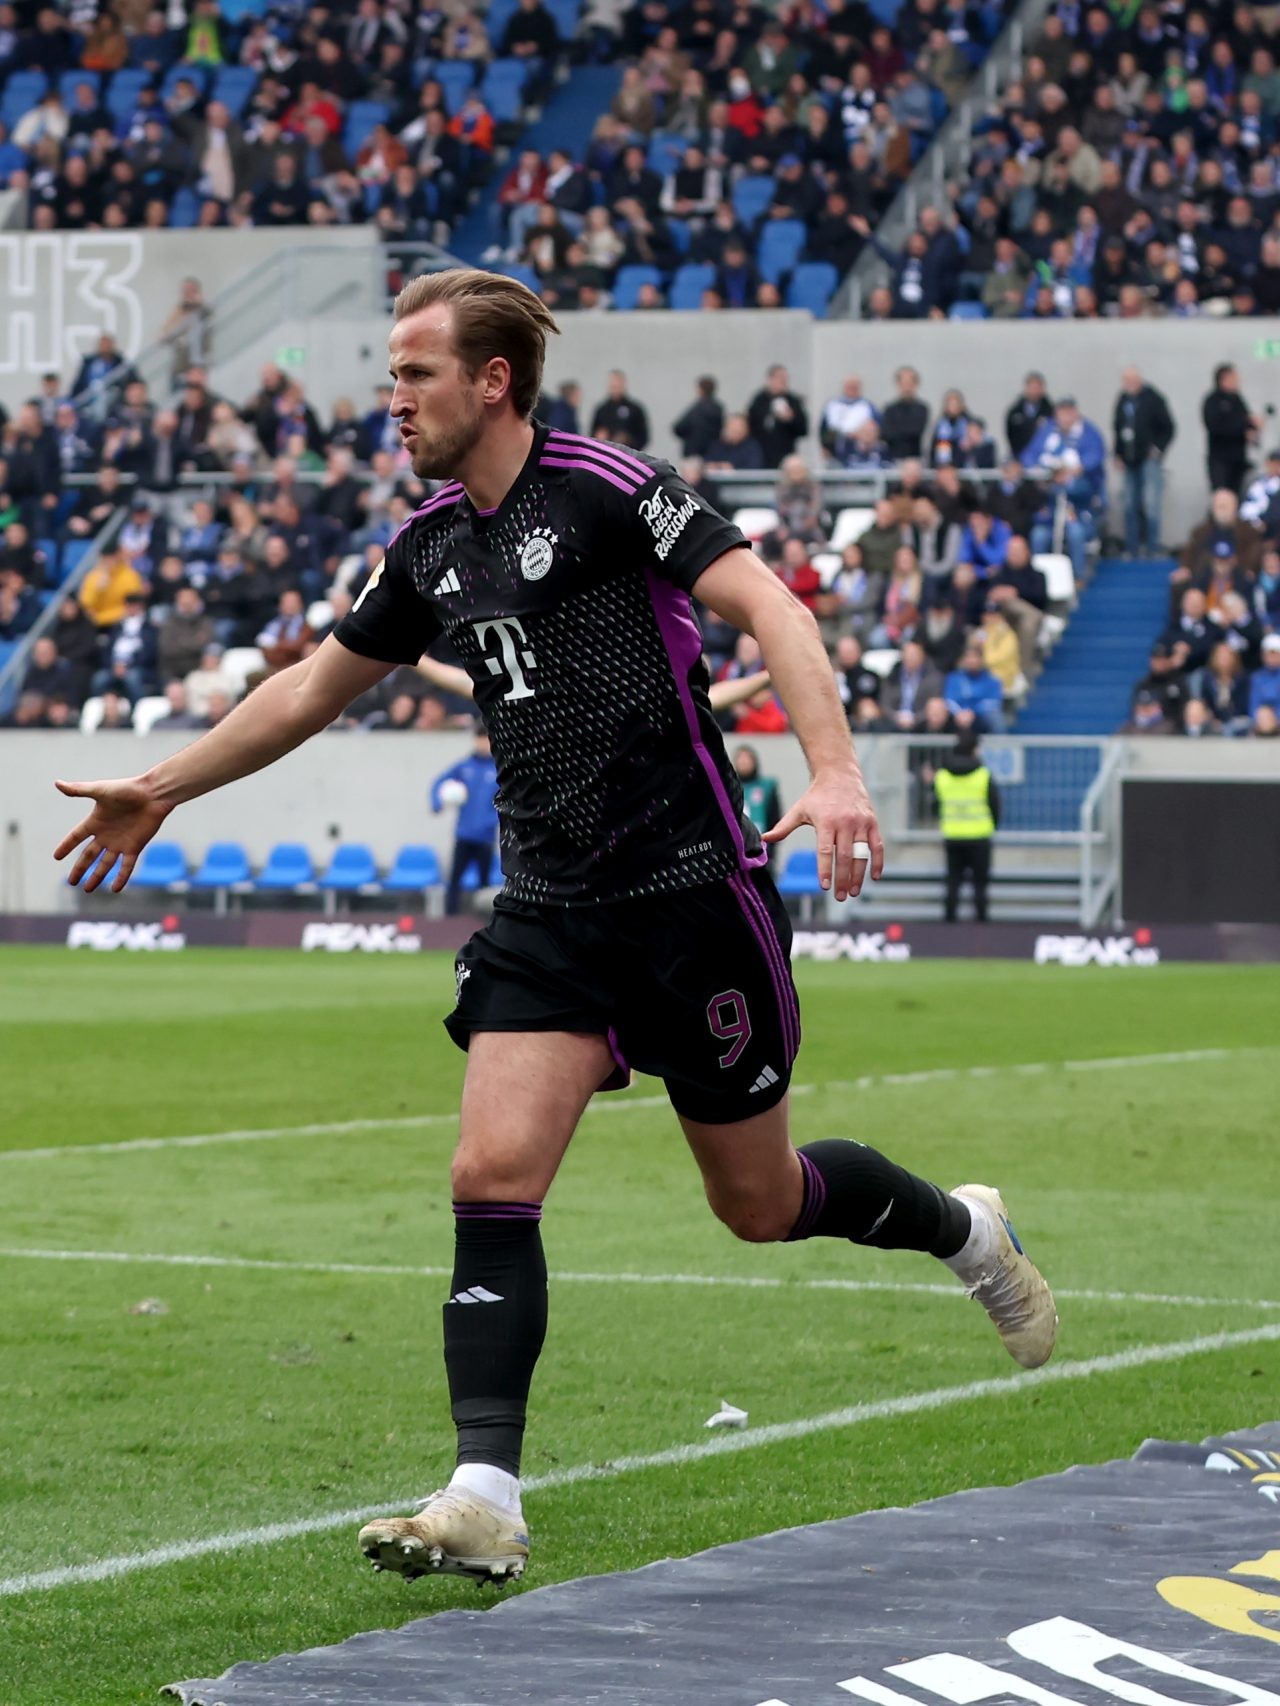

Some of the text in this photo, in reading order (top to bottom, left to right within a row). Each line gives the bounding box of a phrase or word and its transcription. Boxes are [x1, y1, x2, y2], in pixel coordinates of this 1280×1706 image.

[638, 485, 665, 527] ROT
[472, 616, 538, 701] T
[677, 840, 713, 859] HEAT.RDY
[67, 921, 161, 950] PEAK
[302, 922, 397, 952] PEAK
[791, 930, 886, 961] PEAK
[1035, 934, 1134, 966] PEAK
[706, 988, 752, 1069] 9
